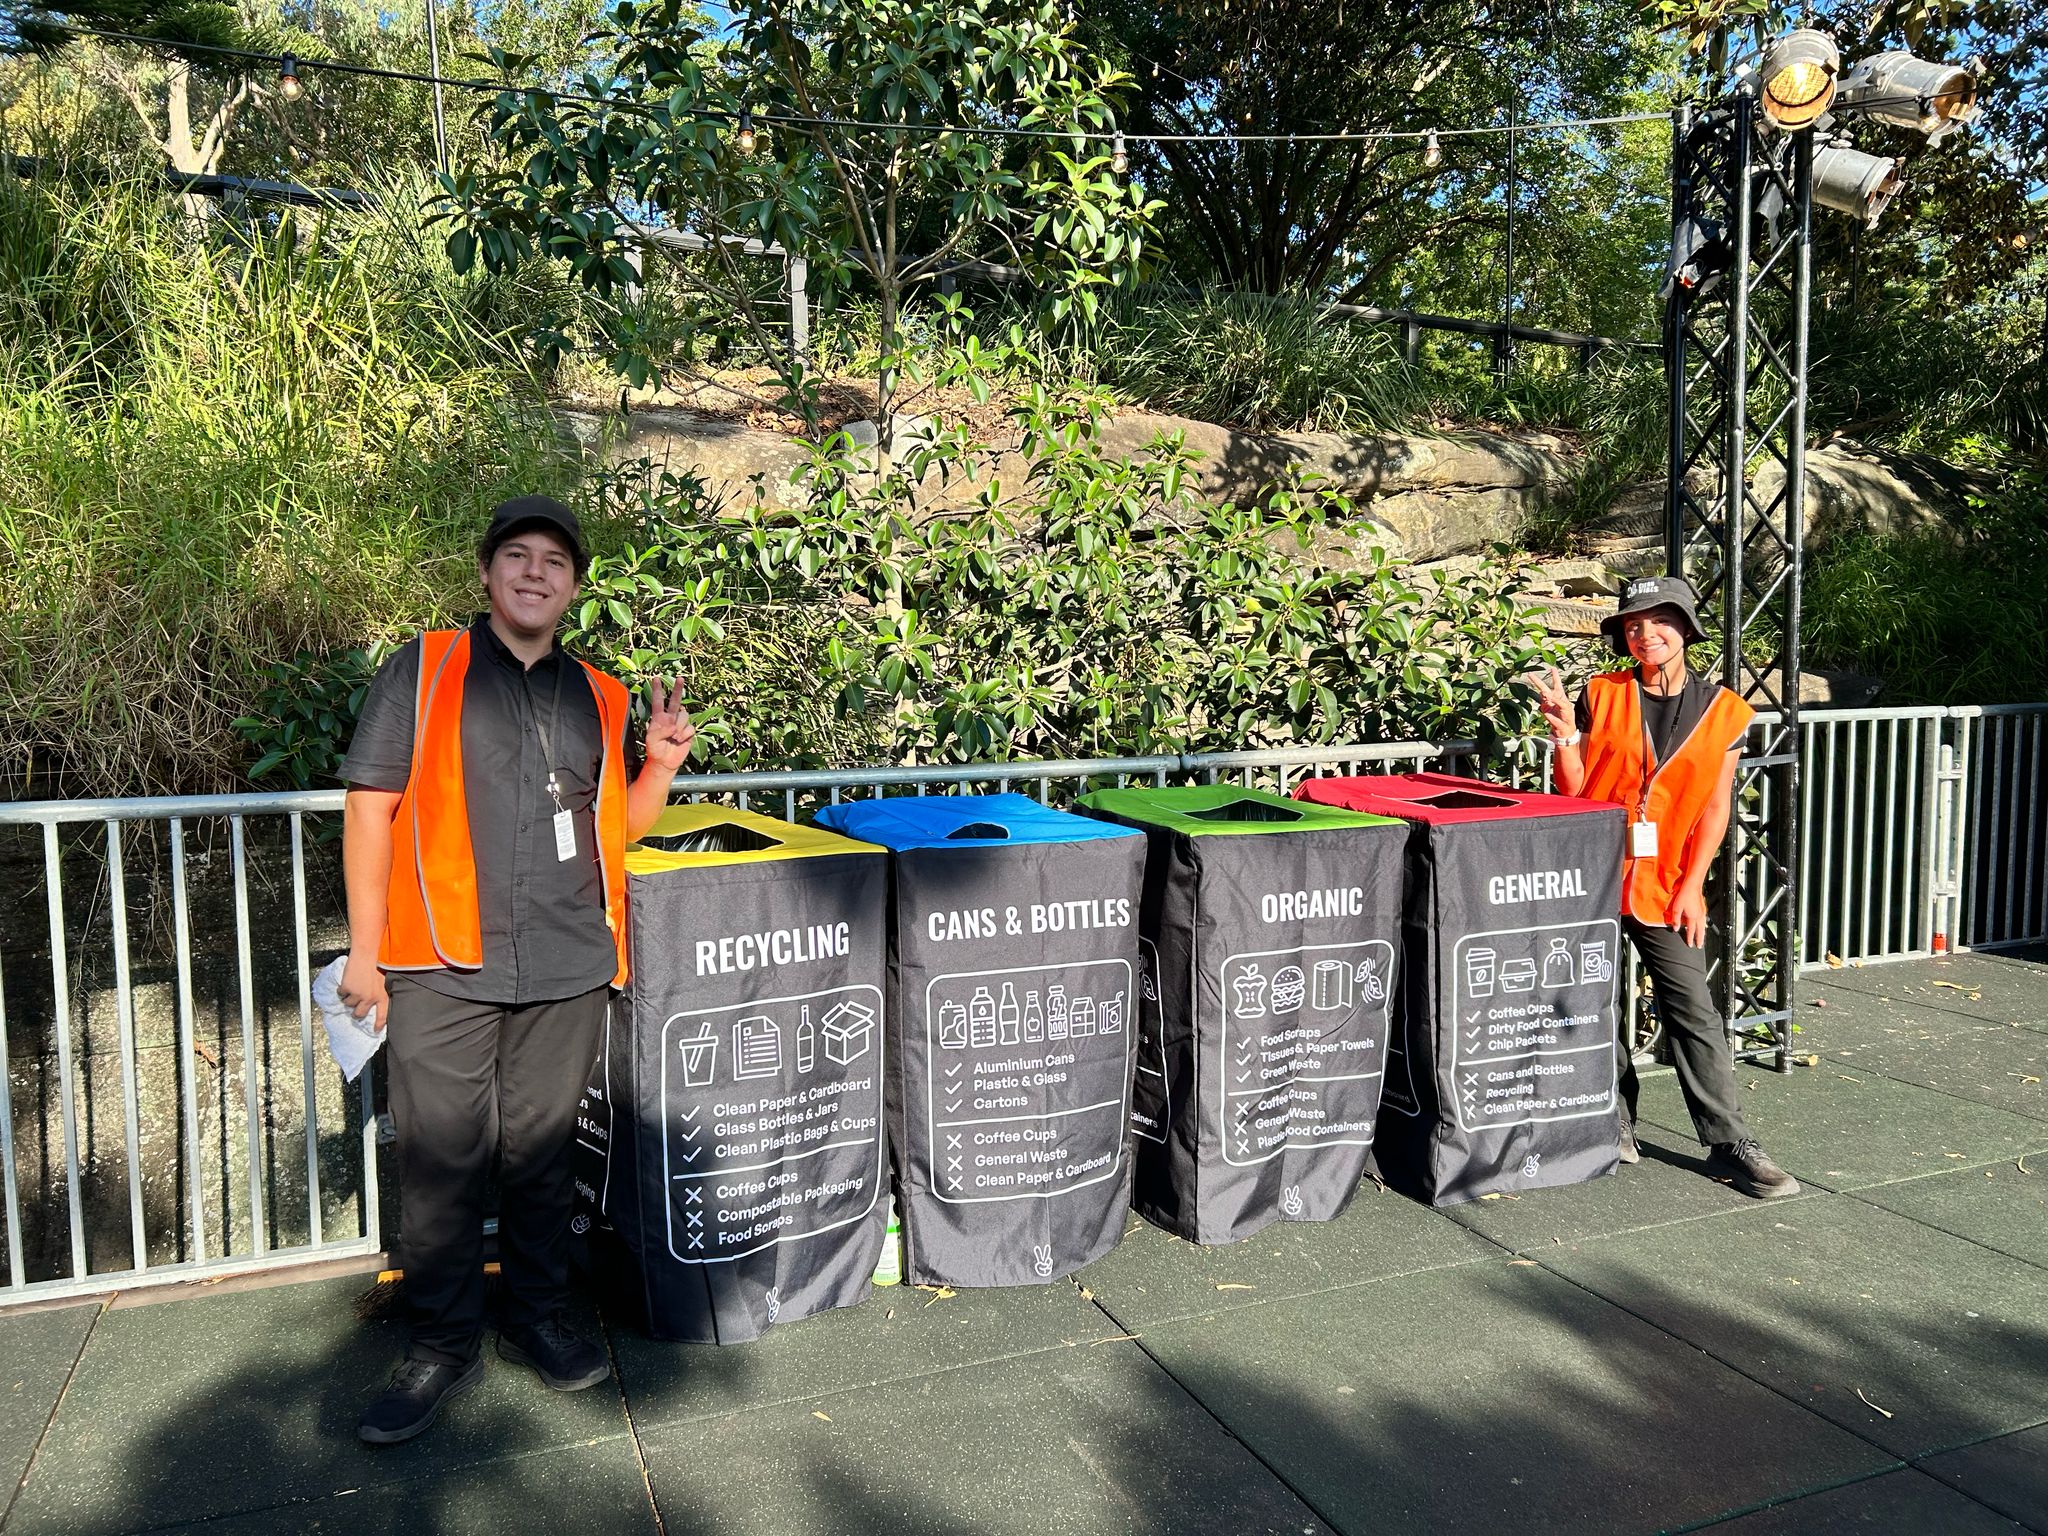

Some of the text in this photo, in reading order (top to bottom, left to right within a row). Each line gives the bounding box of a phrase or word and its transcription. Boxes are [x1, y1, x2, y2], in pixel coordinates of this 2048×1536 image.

[1489, 868, 1587, 905] GENERAL
[1262, 886, 1363, 923] ORGANIC
[928, 898, 1130, 942] CANS & BOTTLES
[695, 921, 850, 976] RECYCLING
[1489, 1004, 1554, 1019] Coffee Cups
[1489, 1014, 1599, 1035] Dirty Food Containers
[1260, 1028, 1321, 1047] Food Scraps
[1488, 1034, 1557, 1051] Chip Packets
[1260, 1038, 1375, 1062] Tissues & Paper Towels
[974, 1053, 1075, 1074] Aluminium Cans
[1260, 1059, 1321, 1079] Green Waste
[1487, 1064, 1575, 1082] Cans and Bottles
[974, 1072, 1067, 1091] Plastic & Glass
[1486, 1083, 1534, 1098] Recycling
[713, 1077, 871, 1117] Clean Paper & Cardboard
[974, 1095, 1028, 1110] Cartons
[1258, 1088, 1317, 1111] Coffee Cups
[1484, 1089, 1609, 1115] Clean Paper & Cardboard
[582, 1117, 589, 1130] &
[589, 1120, 608, 1140] Cups
[714, 1102, 839, 1137] Glass Bottles & Jars
[1130, 1111, 1158, 1128] tainers
[1255, 1107, 1325, 1129] Gener Waste
[1312, 1122, 1371, 1136] Containers
[715, 1117, 876, 1158] Clean Plastic Bags & Cups
[974, 1129, 1057, 1144] Coffee Cups
[975, 1148, 1068, 1167] General Waste
[975, 1152, 1112, 1187] Clean Paper & Cardboard
[575, 1176, 596, 1202] kaging
[716, 1172, 798, 1199] Coffee Cups
[717, 1177, 863, 1222] Compostable Packaging
[718, 1214, 793, 1245] Food Scraps
